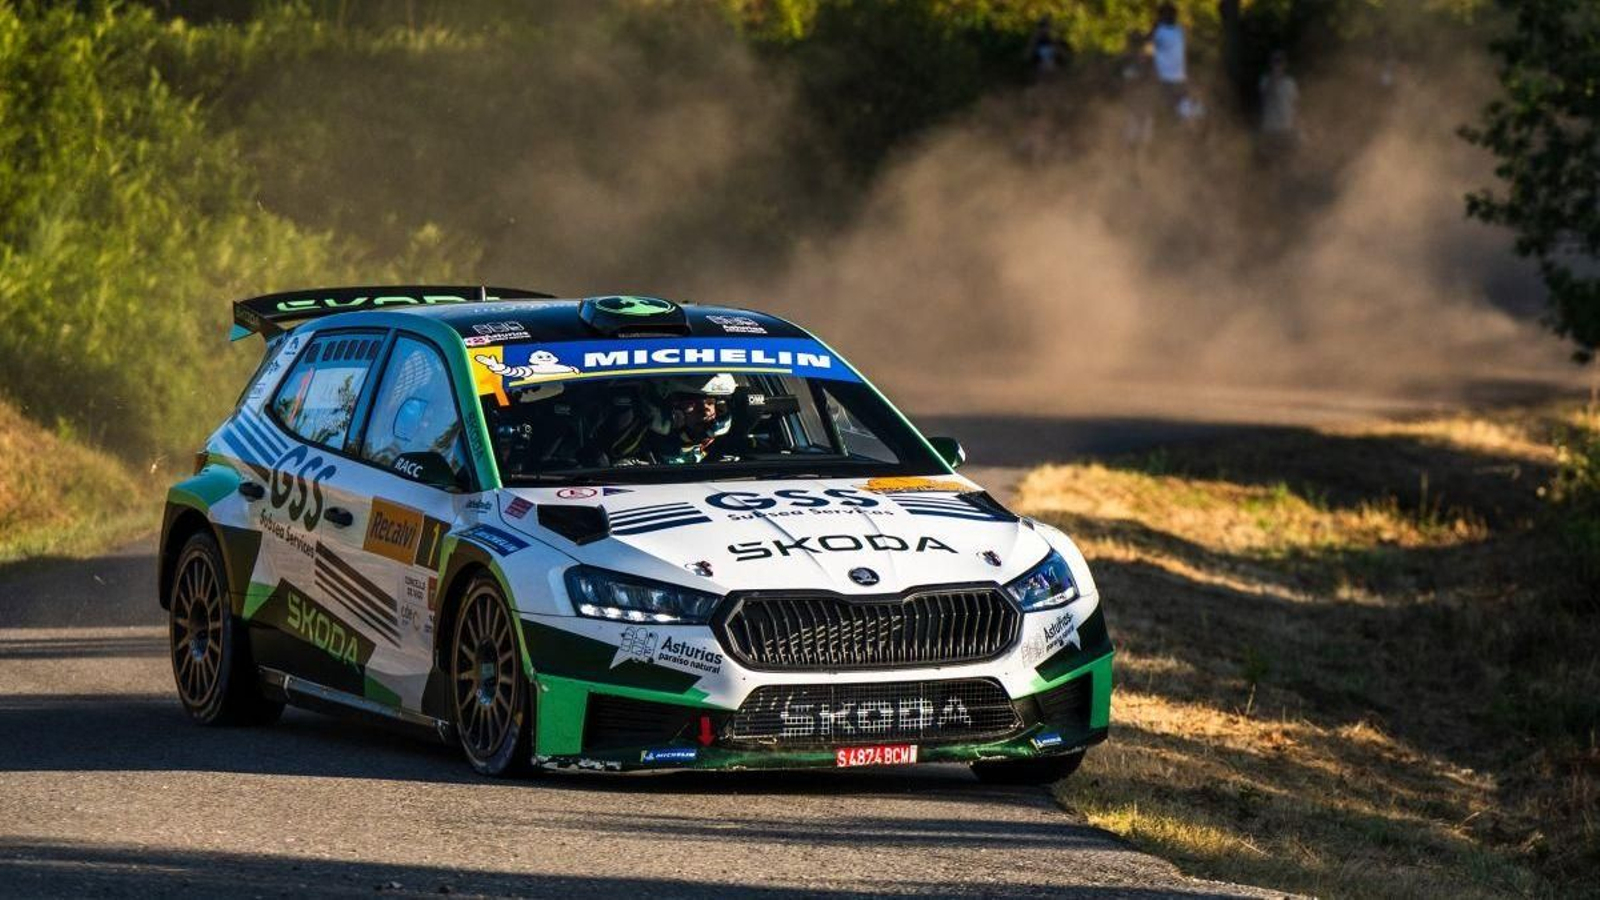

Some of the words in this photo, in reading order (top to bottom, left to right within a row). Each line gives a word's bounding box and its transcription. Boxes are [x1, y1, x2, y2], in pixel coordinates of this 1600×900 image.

[583, 348, 831, 369] MICHELIN
[270, 444, 337, 532] GSS
[705, 489, 879, 511] GSS
[259, 509, 285, 539] Subsea
[369, 511, 418, 549] Recalvi
[727, 509, 804, 521] Subsea
[428, 523, 441, 566] 1
[727, 533, 960, 562] SKODA
[287, 590, 361, 674] SKODA
[660, 635, 723, 665] Asturias
[690, 660, 720, 674] natural
[780, 696, 971, 737] SKODA
[848, 748, 883, 767] 4874
[884, 747, 910, 765] BCM
